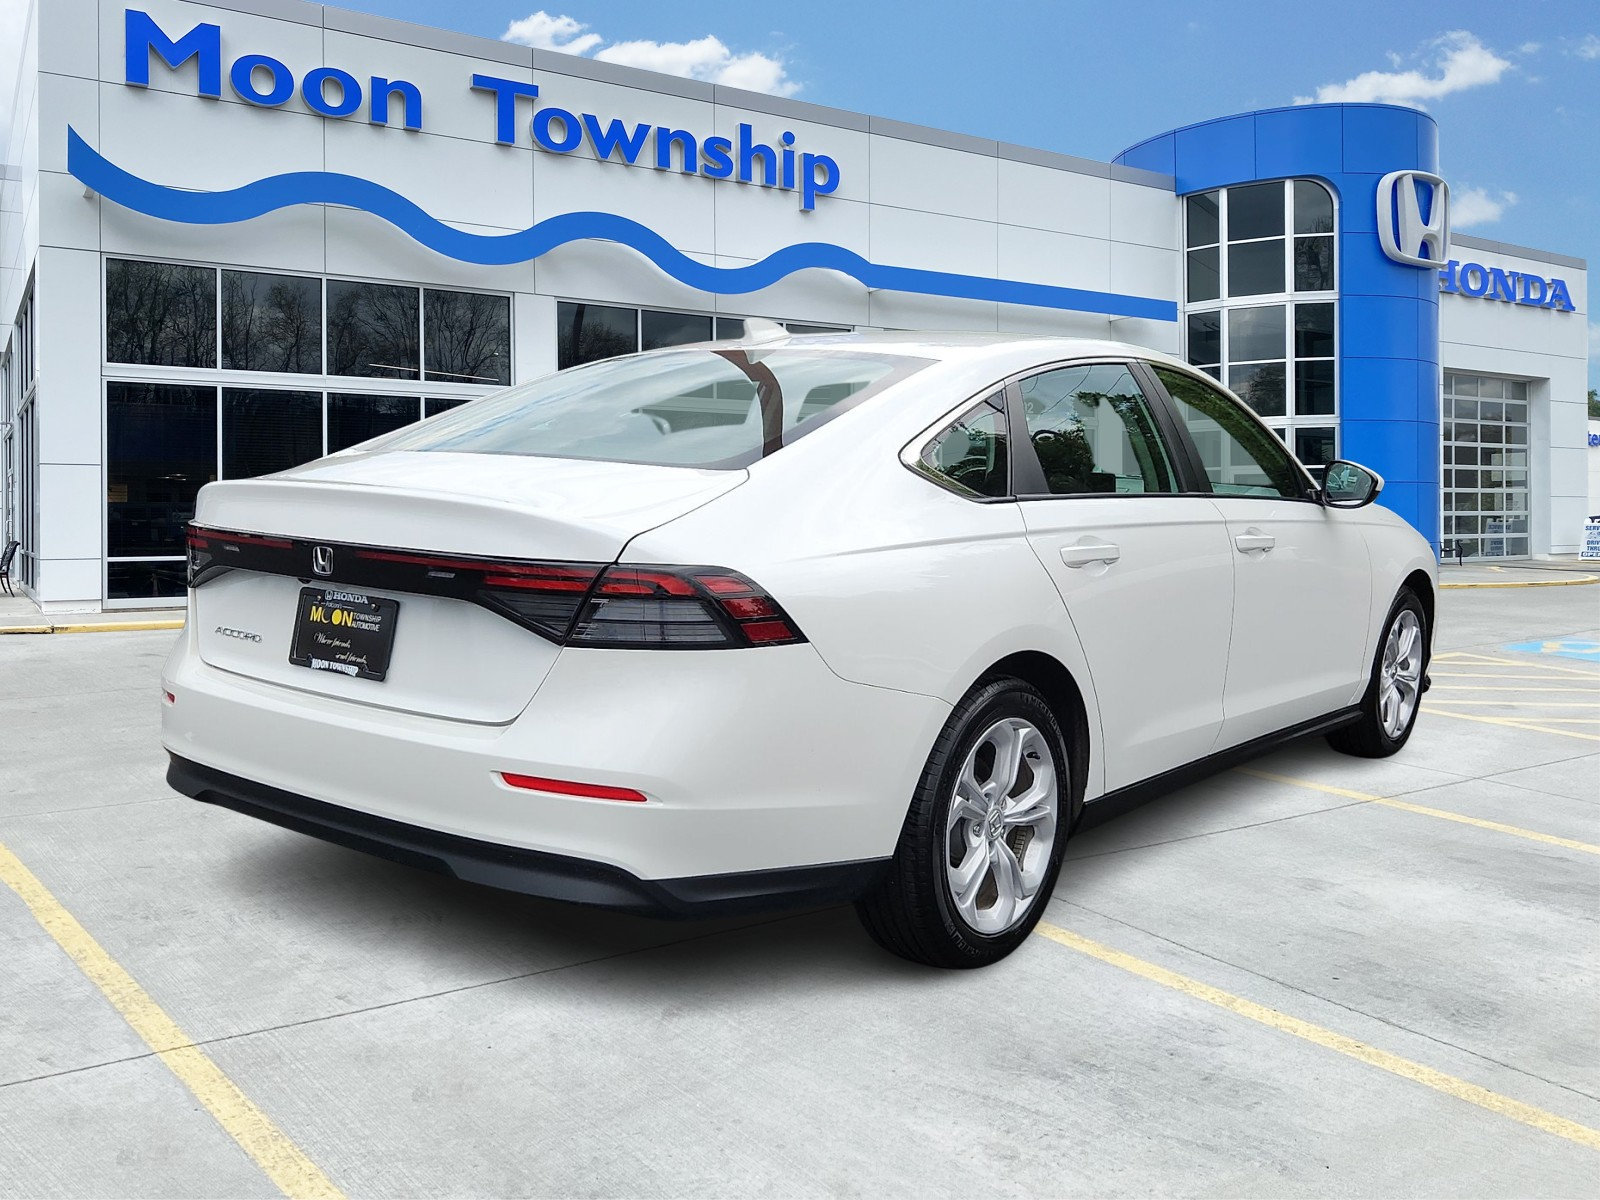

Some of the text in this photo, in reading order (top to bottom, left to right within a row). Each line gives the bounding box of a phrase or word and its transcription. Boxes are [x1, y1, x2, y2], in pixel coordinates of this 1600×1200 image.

[124, 9, 841, 211] Moon Township
[1438, 260, 1576, 311] HONDA
[333, 592, 369, 604] HONDA
[309, 605, 382, 627] MOON TOWNSHIP
[214, 626, 262, 643] ACCORD
[351, 621, 381, 632] AUTOMOTIVE
[311, 658, 359, 677] MOON TOWNSHIP
